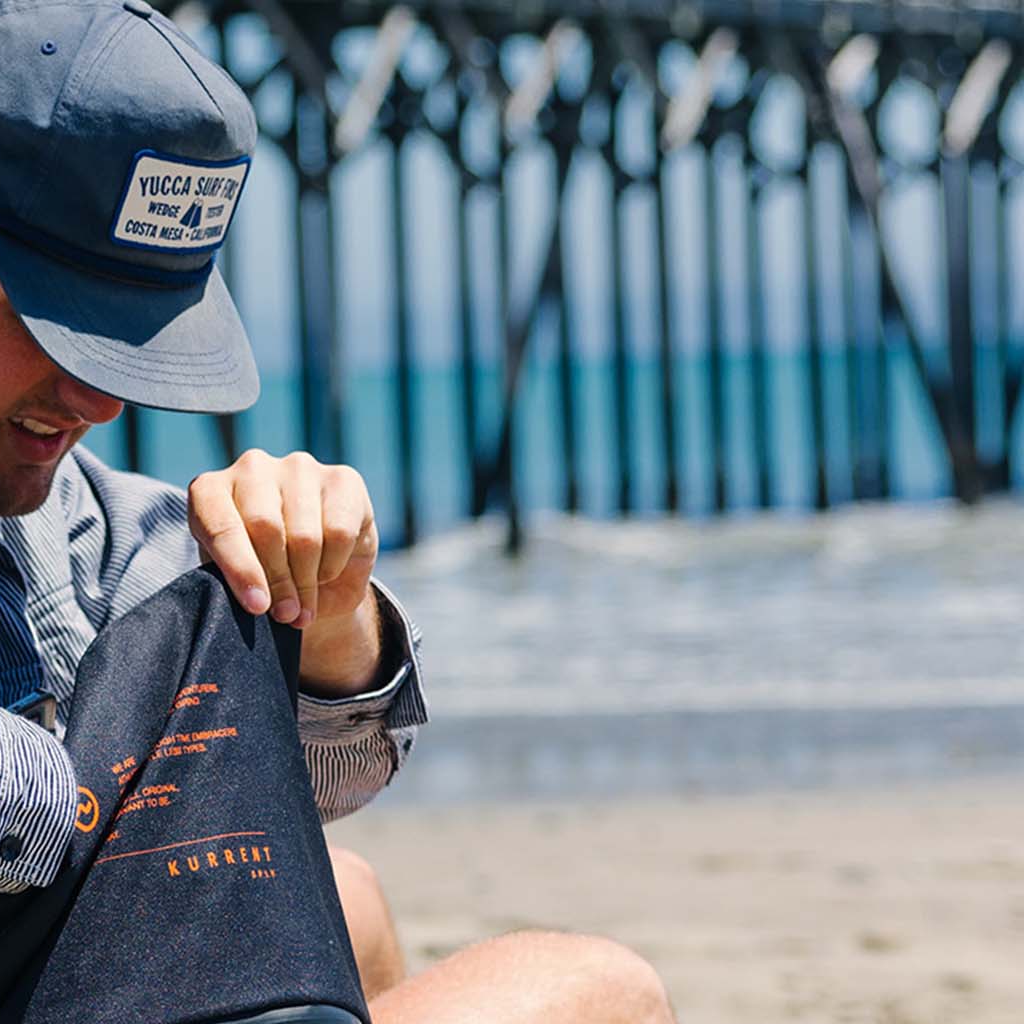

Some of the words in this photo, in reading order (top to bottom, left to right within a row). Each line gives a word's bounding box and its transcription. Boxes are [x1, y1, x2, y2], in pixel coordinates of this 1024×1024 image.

[140, 175, 192, 197] YUCCA
[195, 175, 225, 197] SURF
[147, 202, 182, 218] WEDGE
[125, 220, 158, 239] COSTA
[159, 226, 184, 241] MESA
[167, 845, 272, 877] KURRENT
